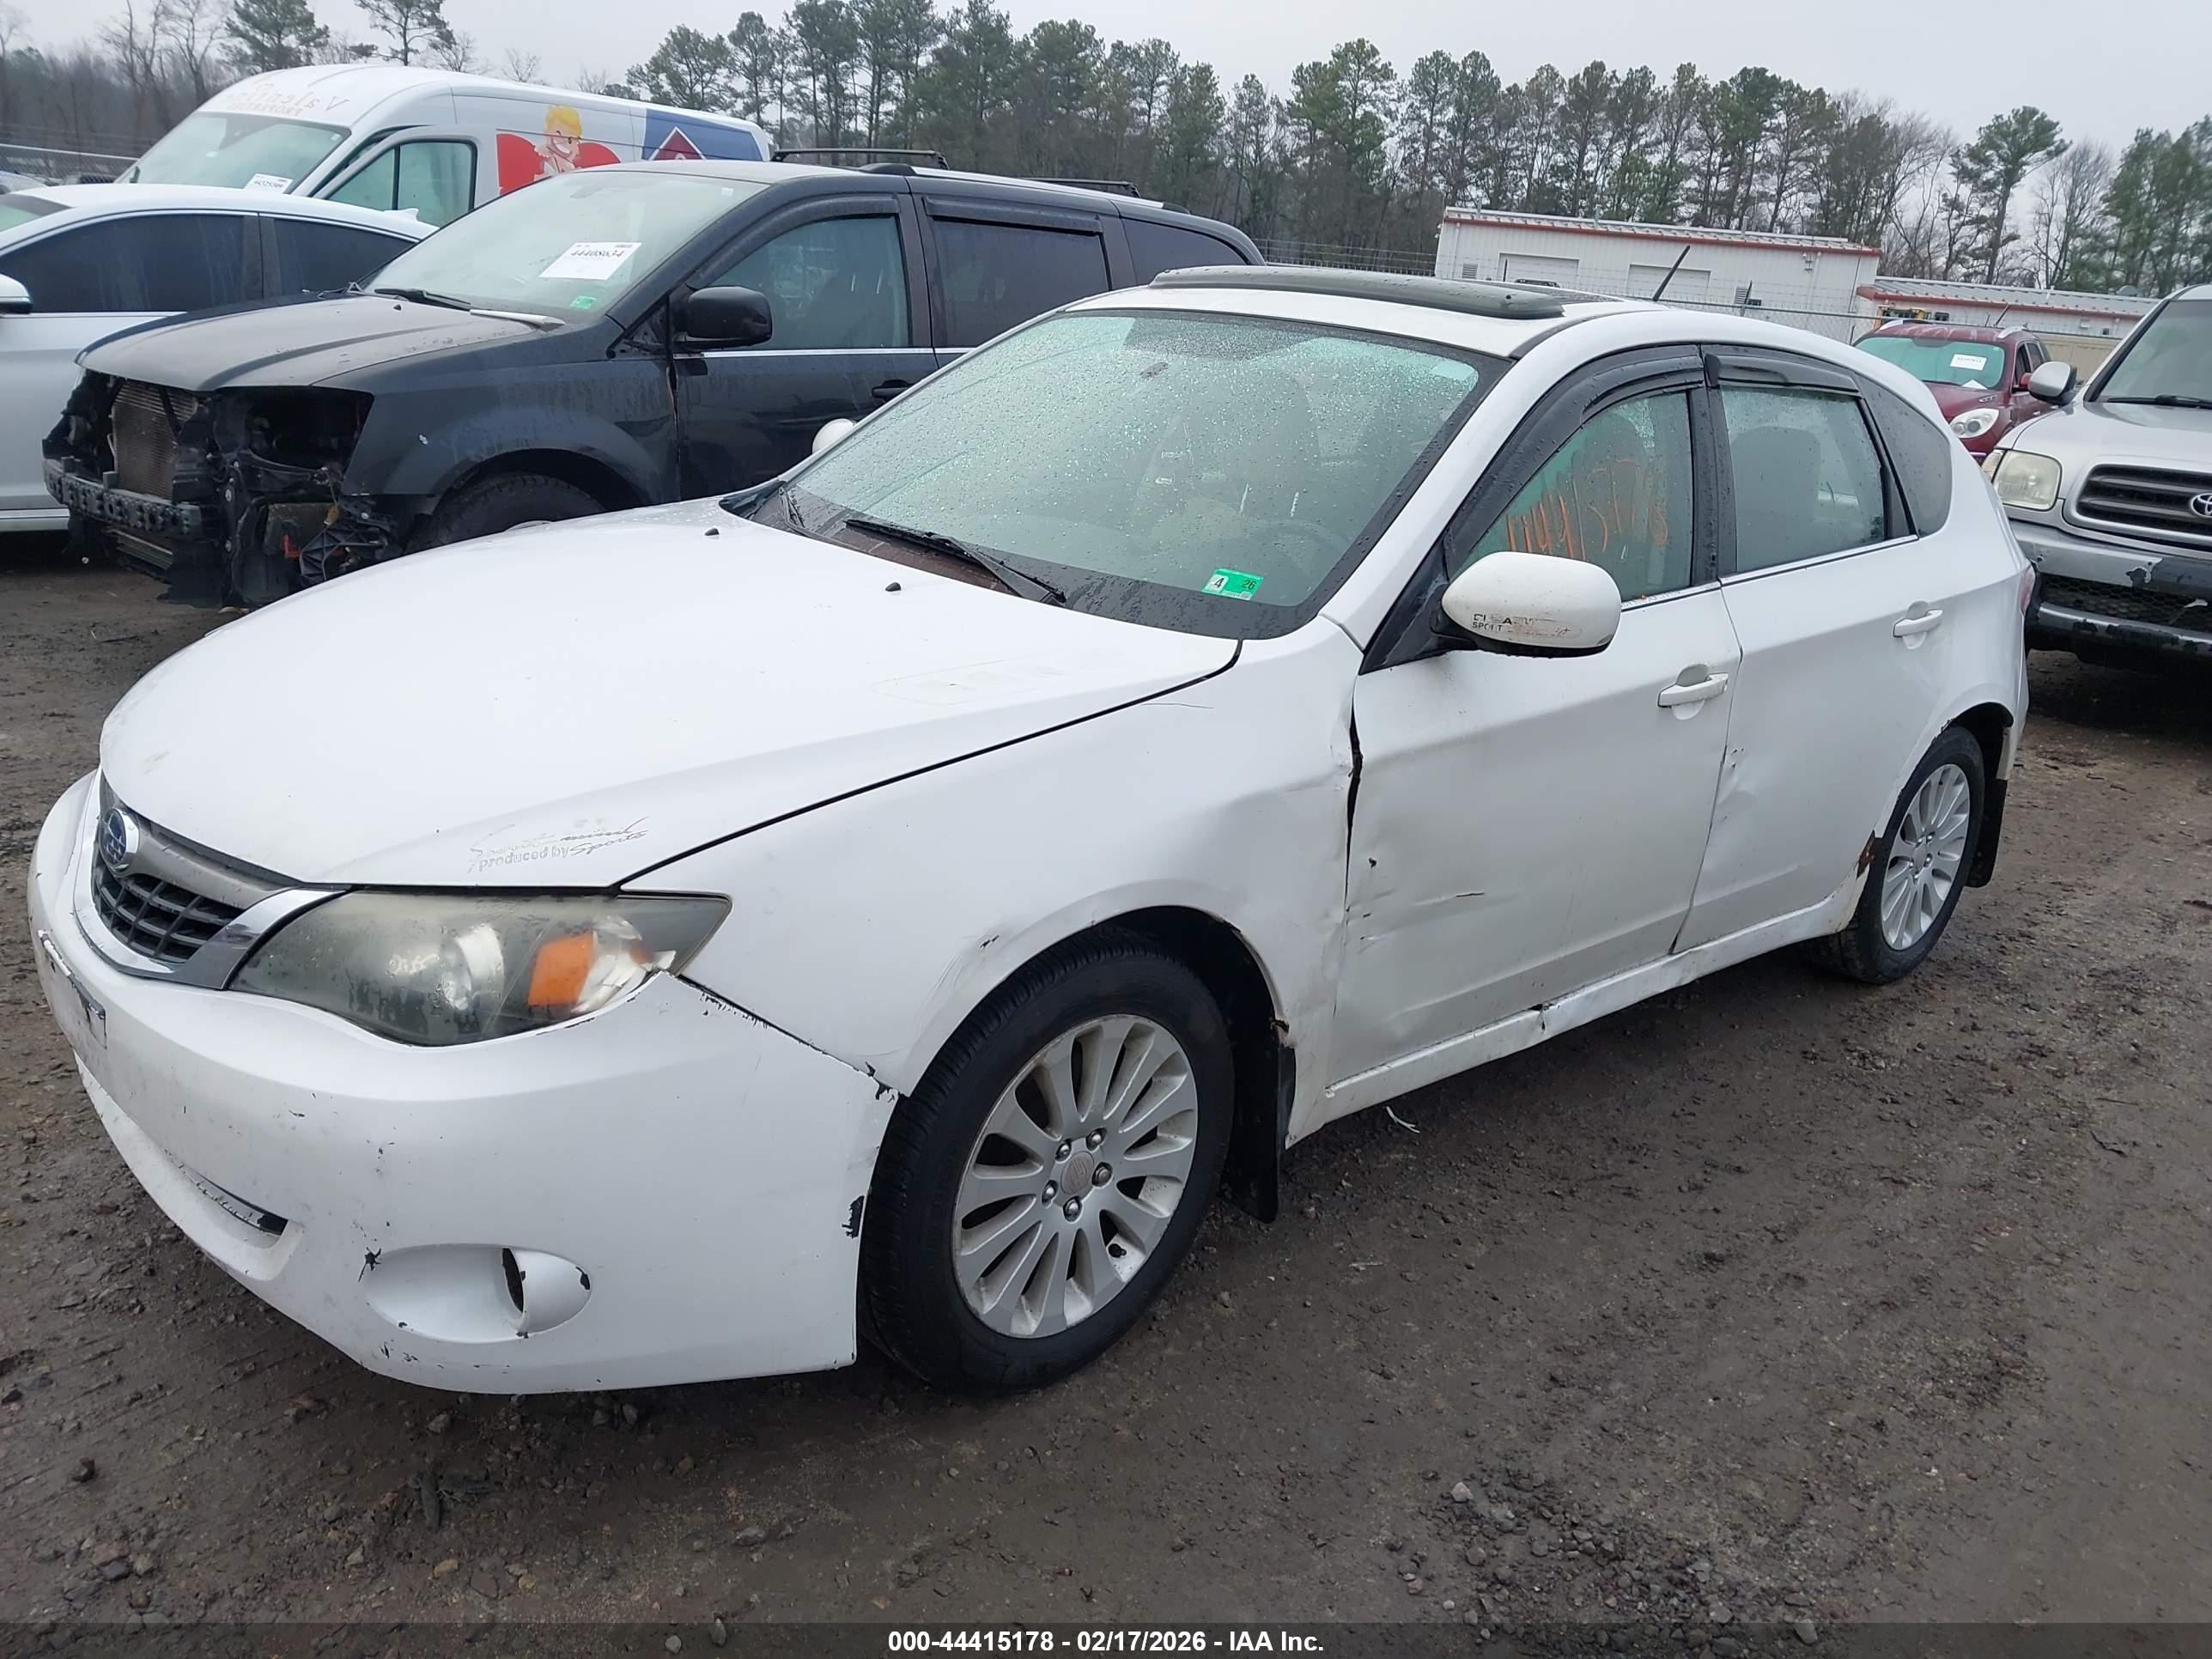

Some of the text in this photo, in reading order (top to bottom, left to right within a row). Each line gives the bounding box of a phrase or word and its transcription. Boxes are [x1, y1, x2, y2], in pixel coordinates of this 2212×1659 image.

[1214, 577, 1257, 590] 4 26
[478, 846, 548, 872] produced
[550, 844, 570, 859] by
